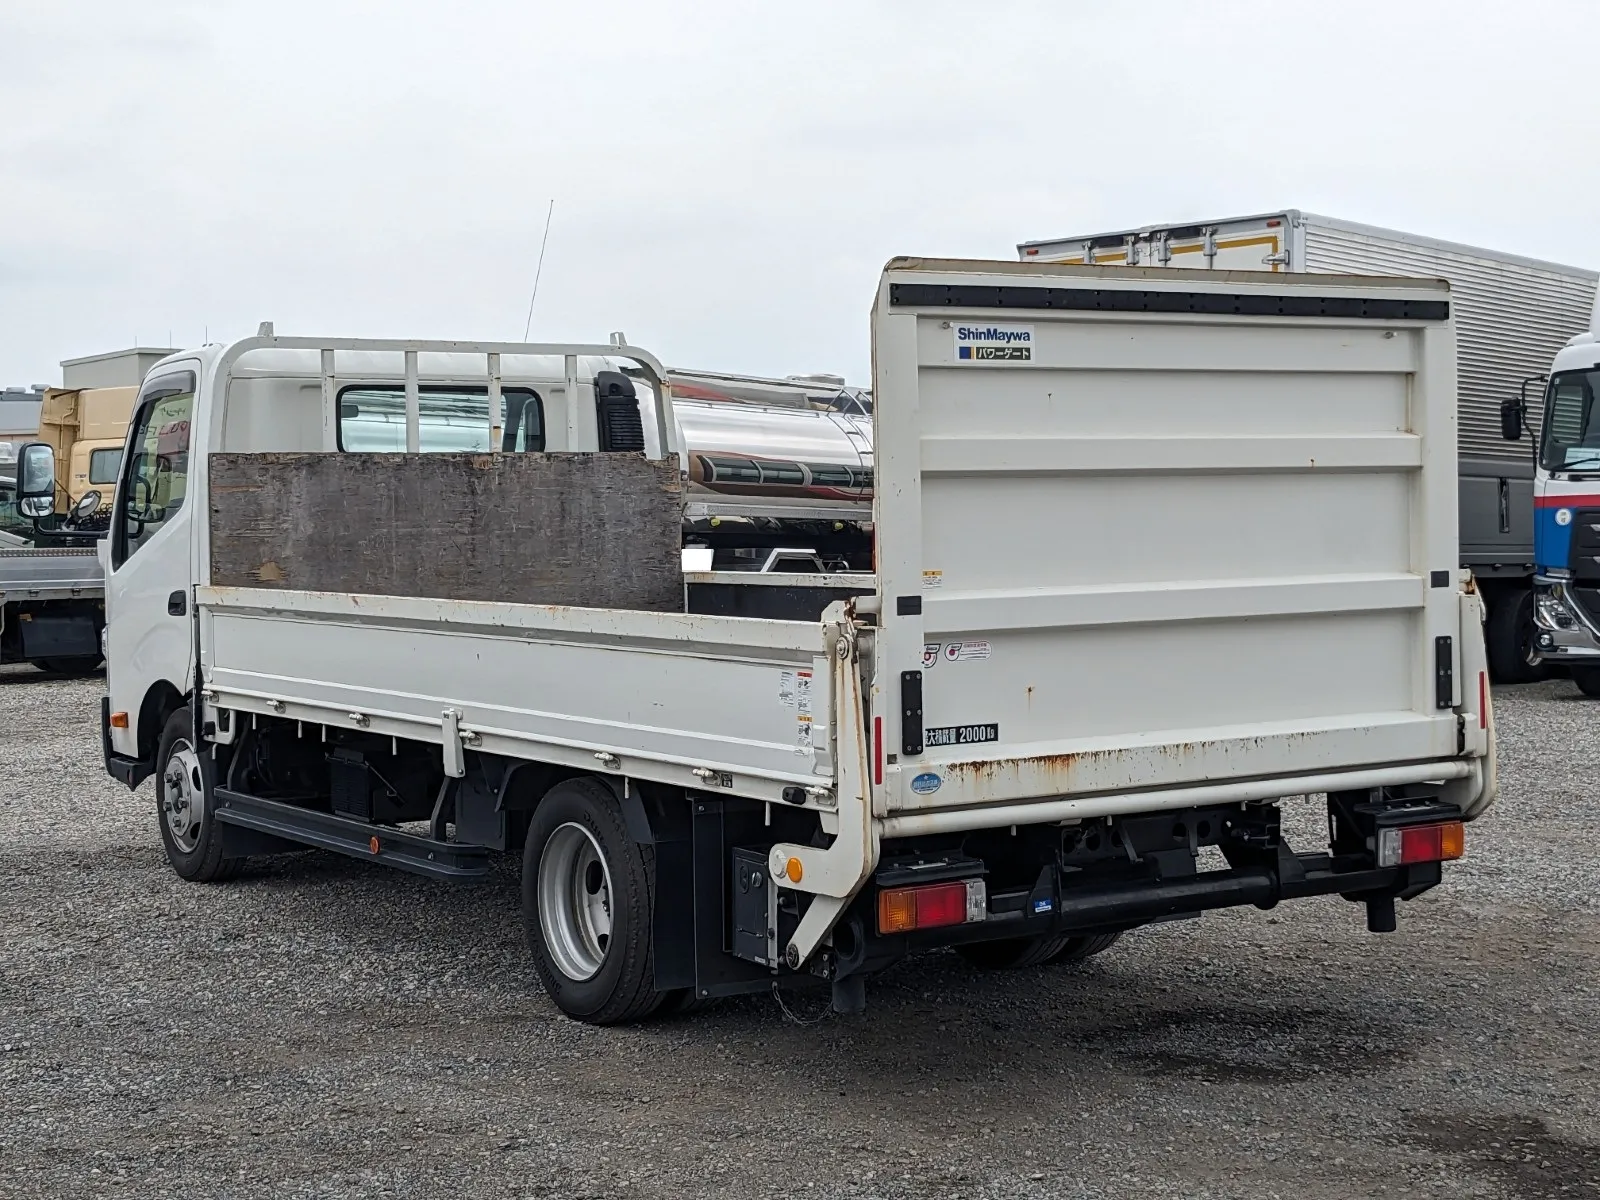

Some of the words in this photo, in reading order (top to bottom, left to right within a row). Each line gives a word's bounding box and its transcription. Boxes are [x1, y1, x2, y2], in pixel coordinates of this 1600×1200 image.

[958, 327, 1030, 343] ShinMaywa
[978, 348, 1029, 359] パワーゲート
